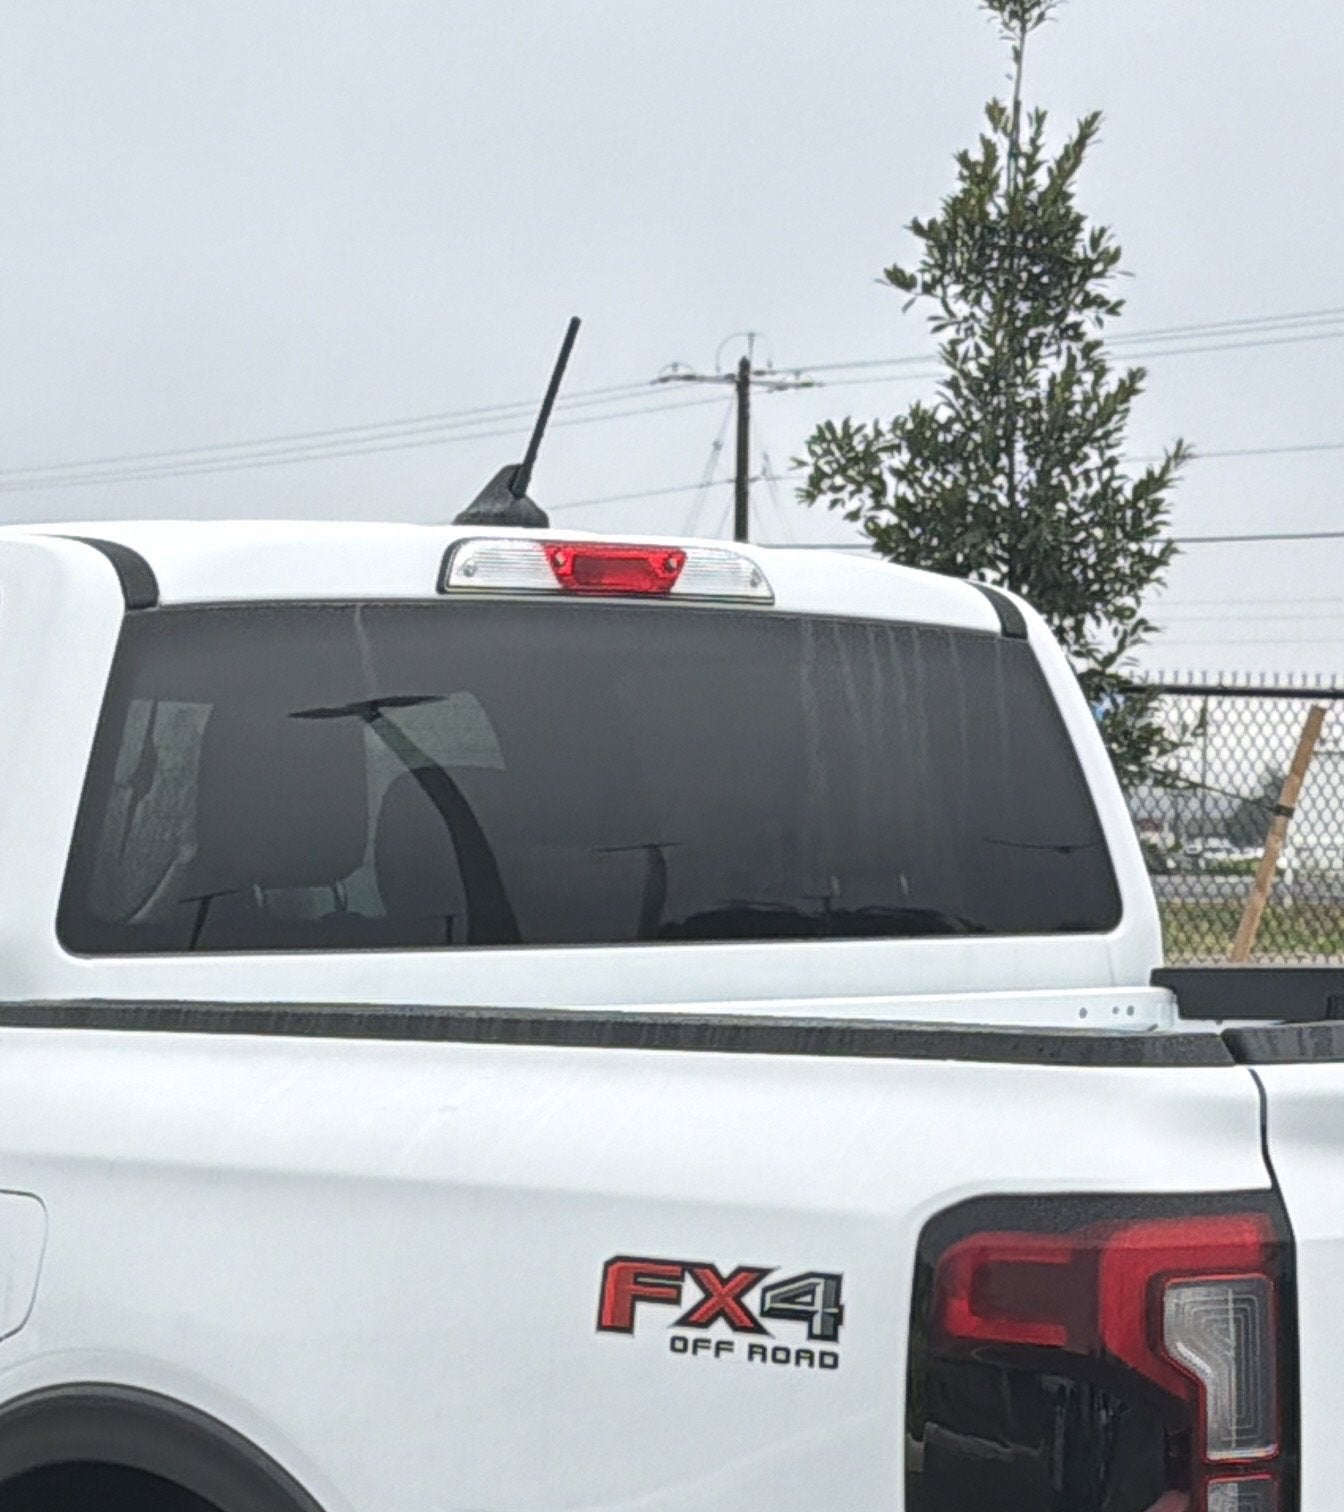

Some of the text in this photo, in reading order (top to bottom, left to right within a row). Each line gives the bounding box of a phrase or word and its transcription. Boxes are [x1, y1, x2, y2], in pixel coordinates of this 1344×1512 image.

[596, 1254, 844, 1342] FX4
[669, 1336, 839, 1369] OFF ROAD
